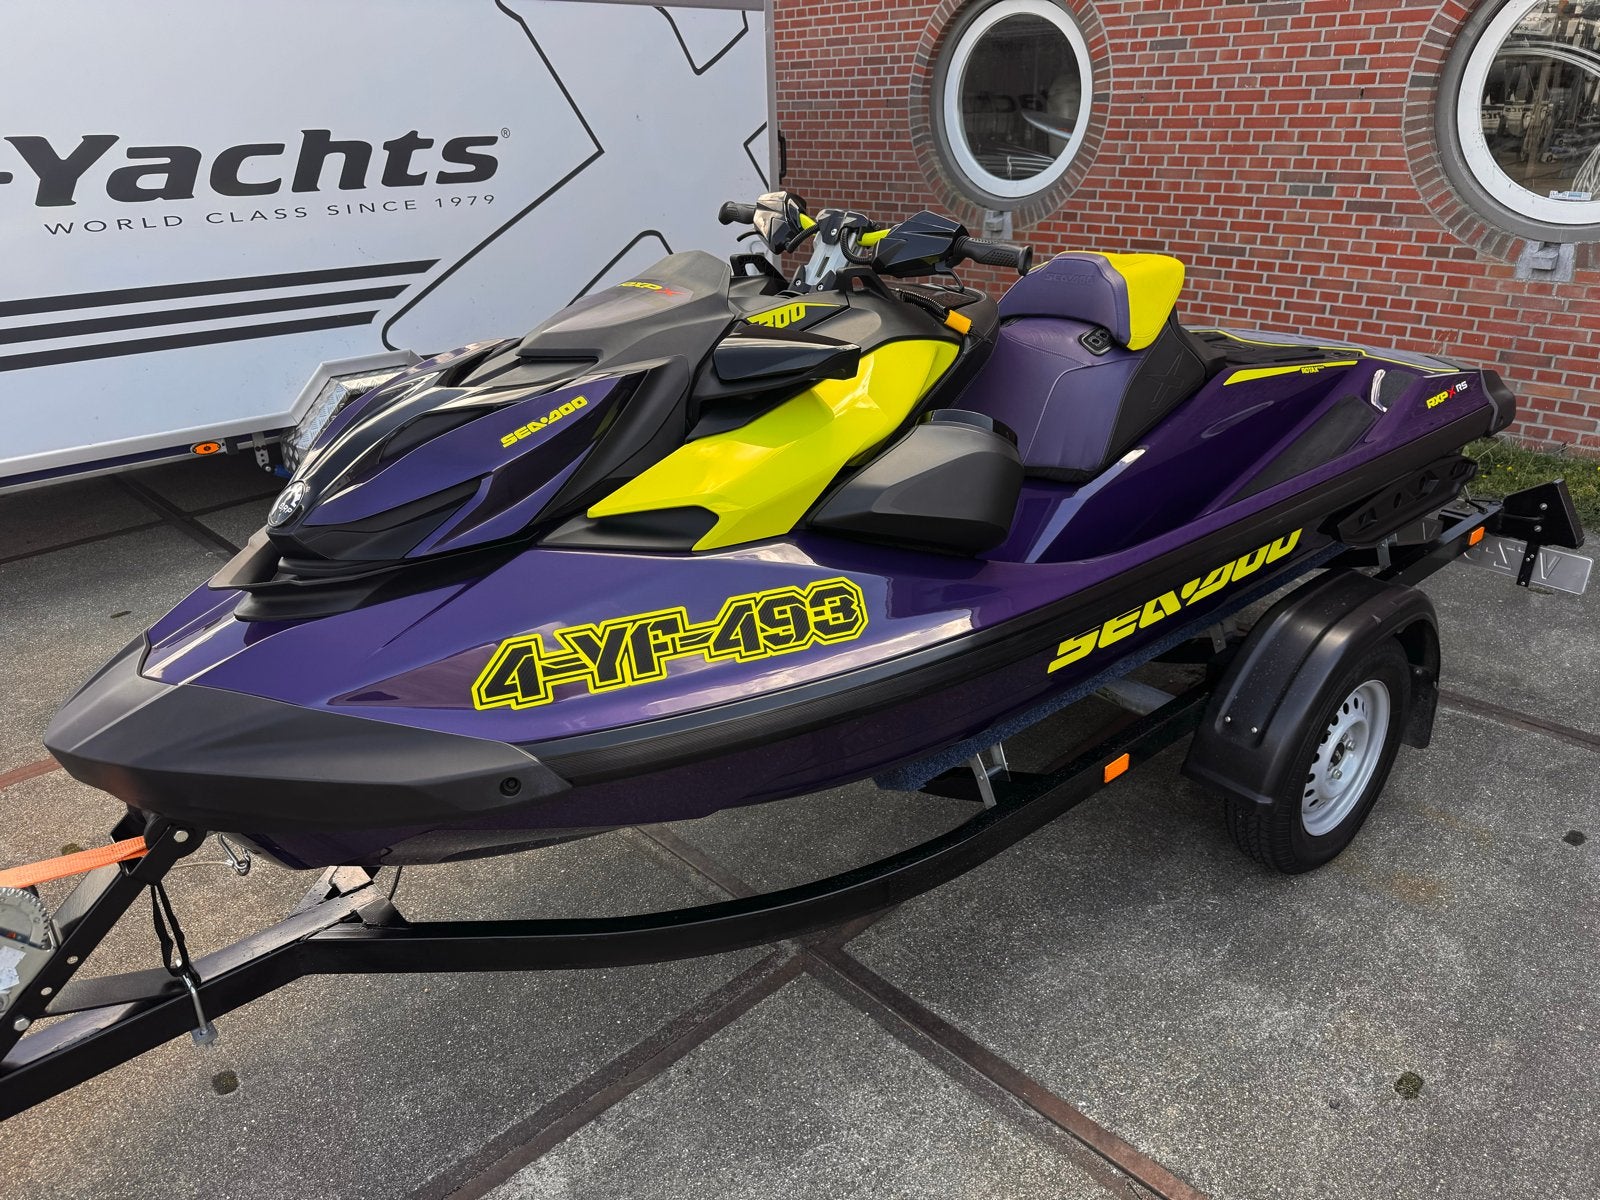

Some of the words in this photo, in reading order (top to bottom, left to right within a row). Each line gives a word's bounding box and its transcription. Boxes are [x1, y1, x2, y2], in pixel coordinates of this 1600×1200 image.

[43, 215, 183, 235] WORLD
[205, 206, 308, 224] CLASS
[326, 199, 417, 216] SINCE
[434, 194, 495, 208] 1979
[1455, 380, 1468, 392] RS
[278, 502, 293, 514] BRP
[471, 576, 869, 711] 4-YF-493
